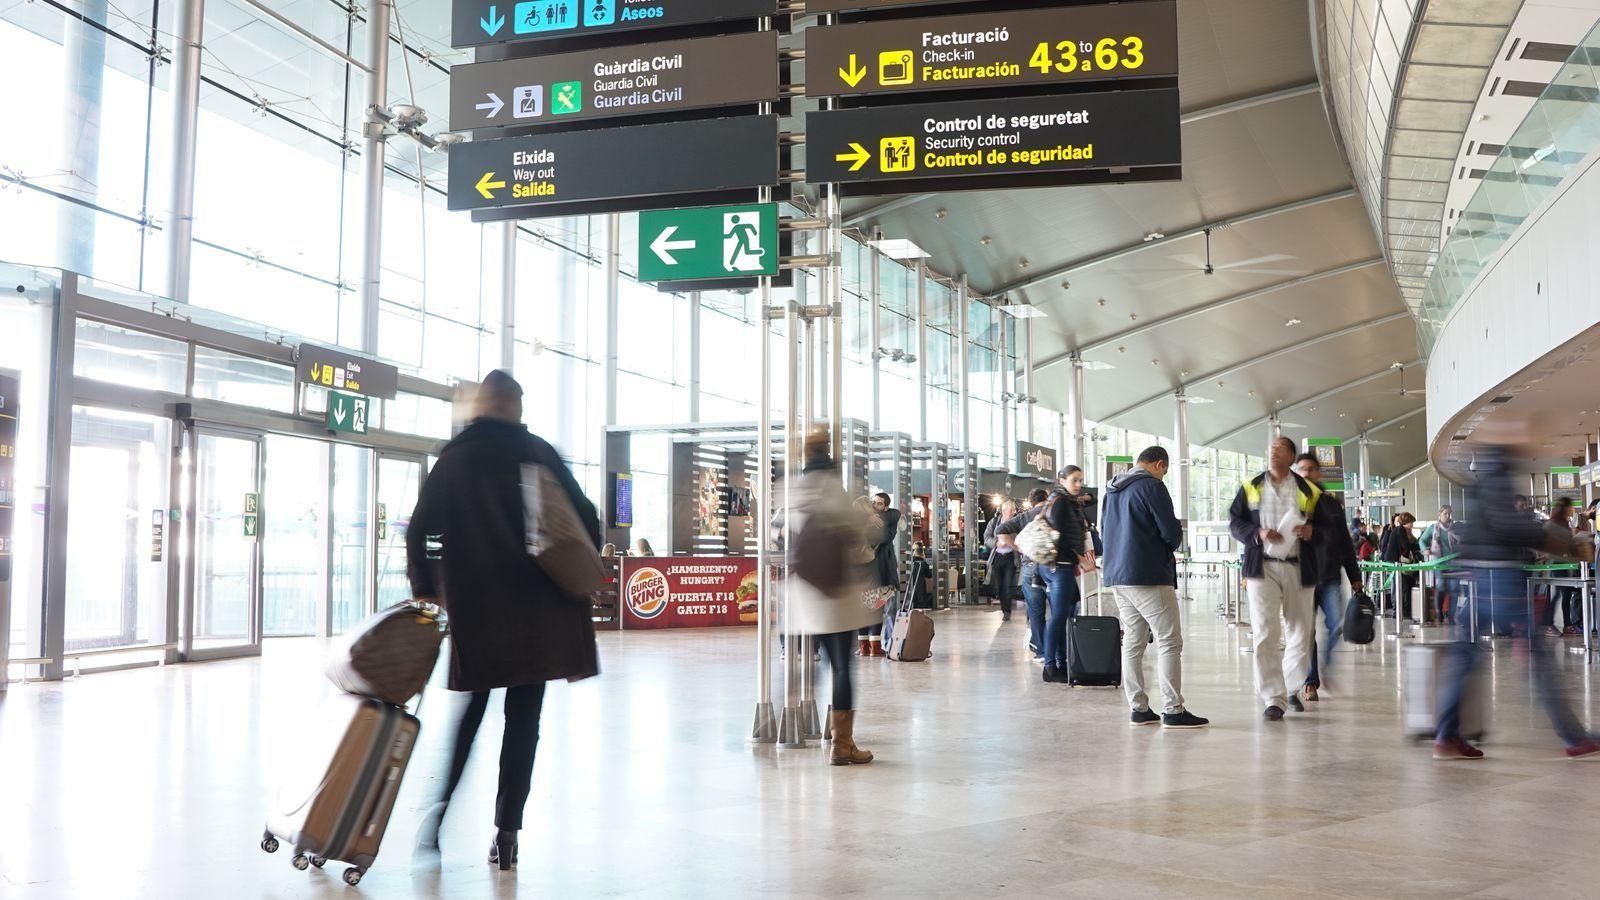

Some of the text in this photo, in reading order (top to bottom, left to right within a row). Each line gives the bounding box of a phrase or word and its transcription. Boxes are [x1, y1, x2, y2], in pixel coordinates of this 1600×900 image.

[621, 6, 664, 21] Aseos
[922, 27, 1009, 47] Facturació
[923, 48, 975, 63] Check-in
[1029, 36, 1144, 74] 43 to a 63
[594, 55, 682, 76] Guàrdia Civil
[922, 61, 1020, 81] Facturación
[594, 74, 658, 92] Guardia Civil
[594, 87, 682, 108] Guardia Civil
[924, 110, 1089, 133] Control de seguretat
[925, 132, 1020, 150] Security control
[513, 149, 555, 165] Eixida
[924, 144, 1093, 168] Control de seguridad
[513, 166, 555, 182] Way out
[512, 181, 555, 198] Salida
[666, 565, 738, 576] ¿HAMBRIENTO?
[631, 576, 663, 595] BURGER
[680, 576, 725, 585] HUNGRY?
[632, 585, 665, 609] KING
[670, 592, 735, 602] PUERTA F18
[677, 605, 728, 615] GATE F18
